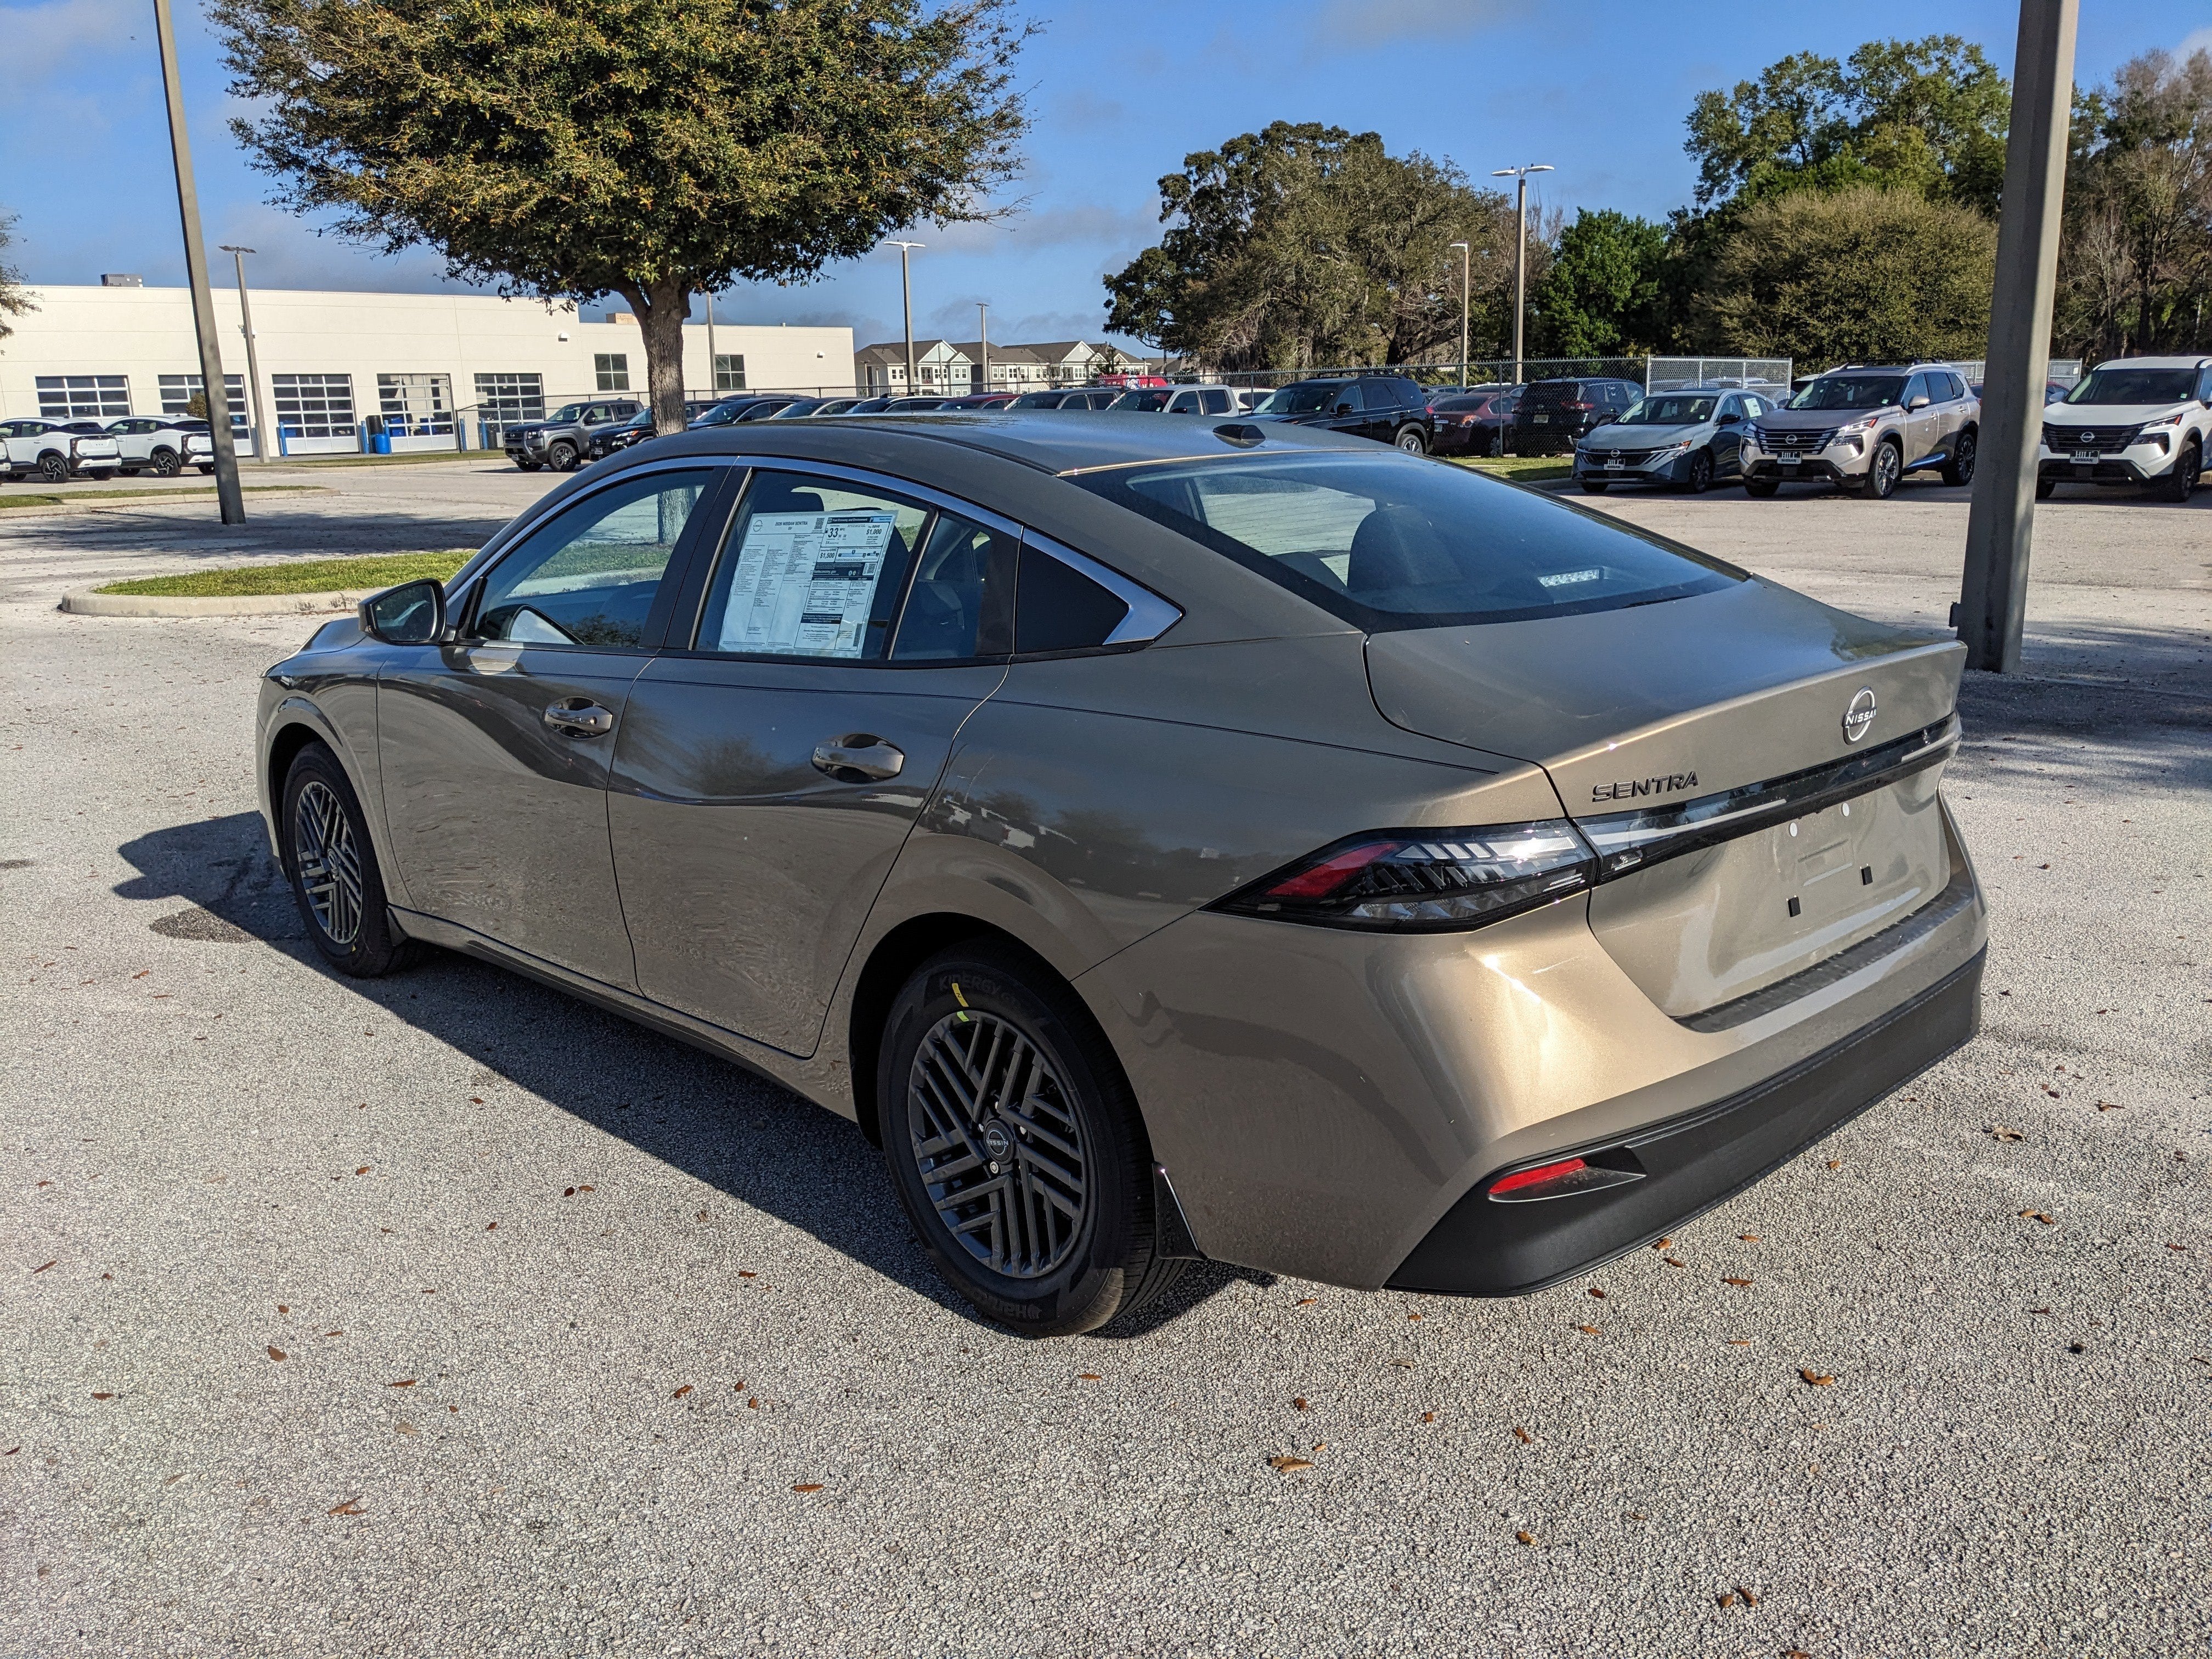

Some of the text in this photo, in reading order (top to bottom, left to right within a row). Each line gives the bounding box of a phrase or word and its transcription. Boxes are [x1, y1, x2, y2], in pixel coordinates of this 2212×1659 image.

[828, 528, 839, 538] 33
[1845, 709, 1876, 725] NISSAN
[1592, 771, 1699, 802] SENTRA
